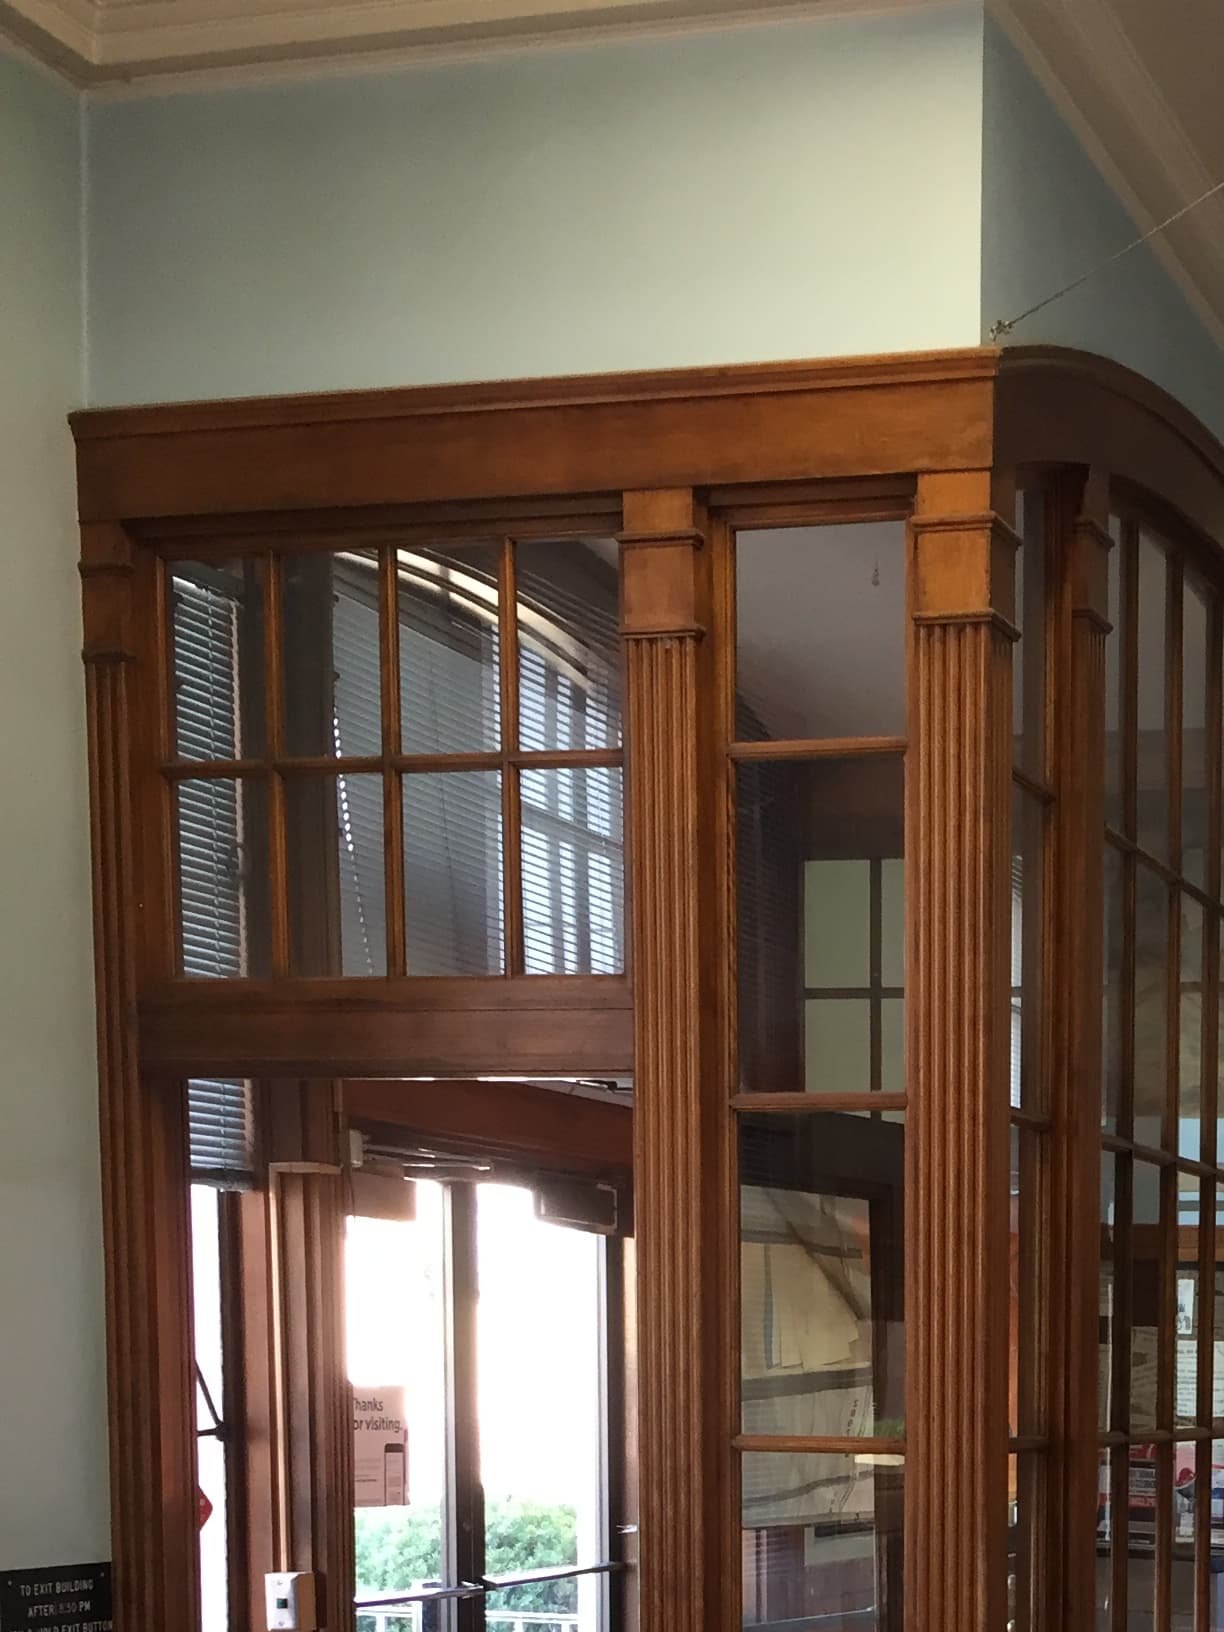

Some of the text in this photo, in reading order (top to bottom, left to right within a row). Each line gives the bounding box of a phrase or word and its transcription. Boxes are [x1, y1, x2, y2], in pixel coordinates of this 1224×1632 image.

[353, 1419, 364, 1431] or
[20, 1579, 94, 1597] TO EXIT BUILDING
[27, 1604, 56, 1618] AFTER
[78, 1600, 91, 1612] PM
